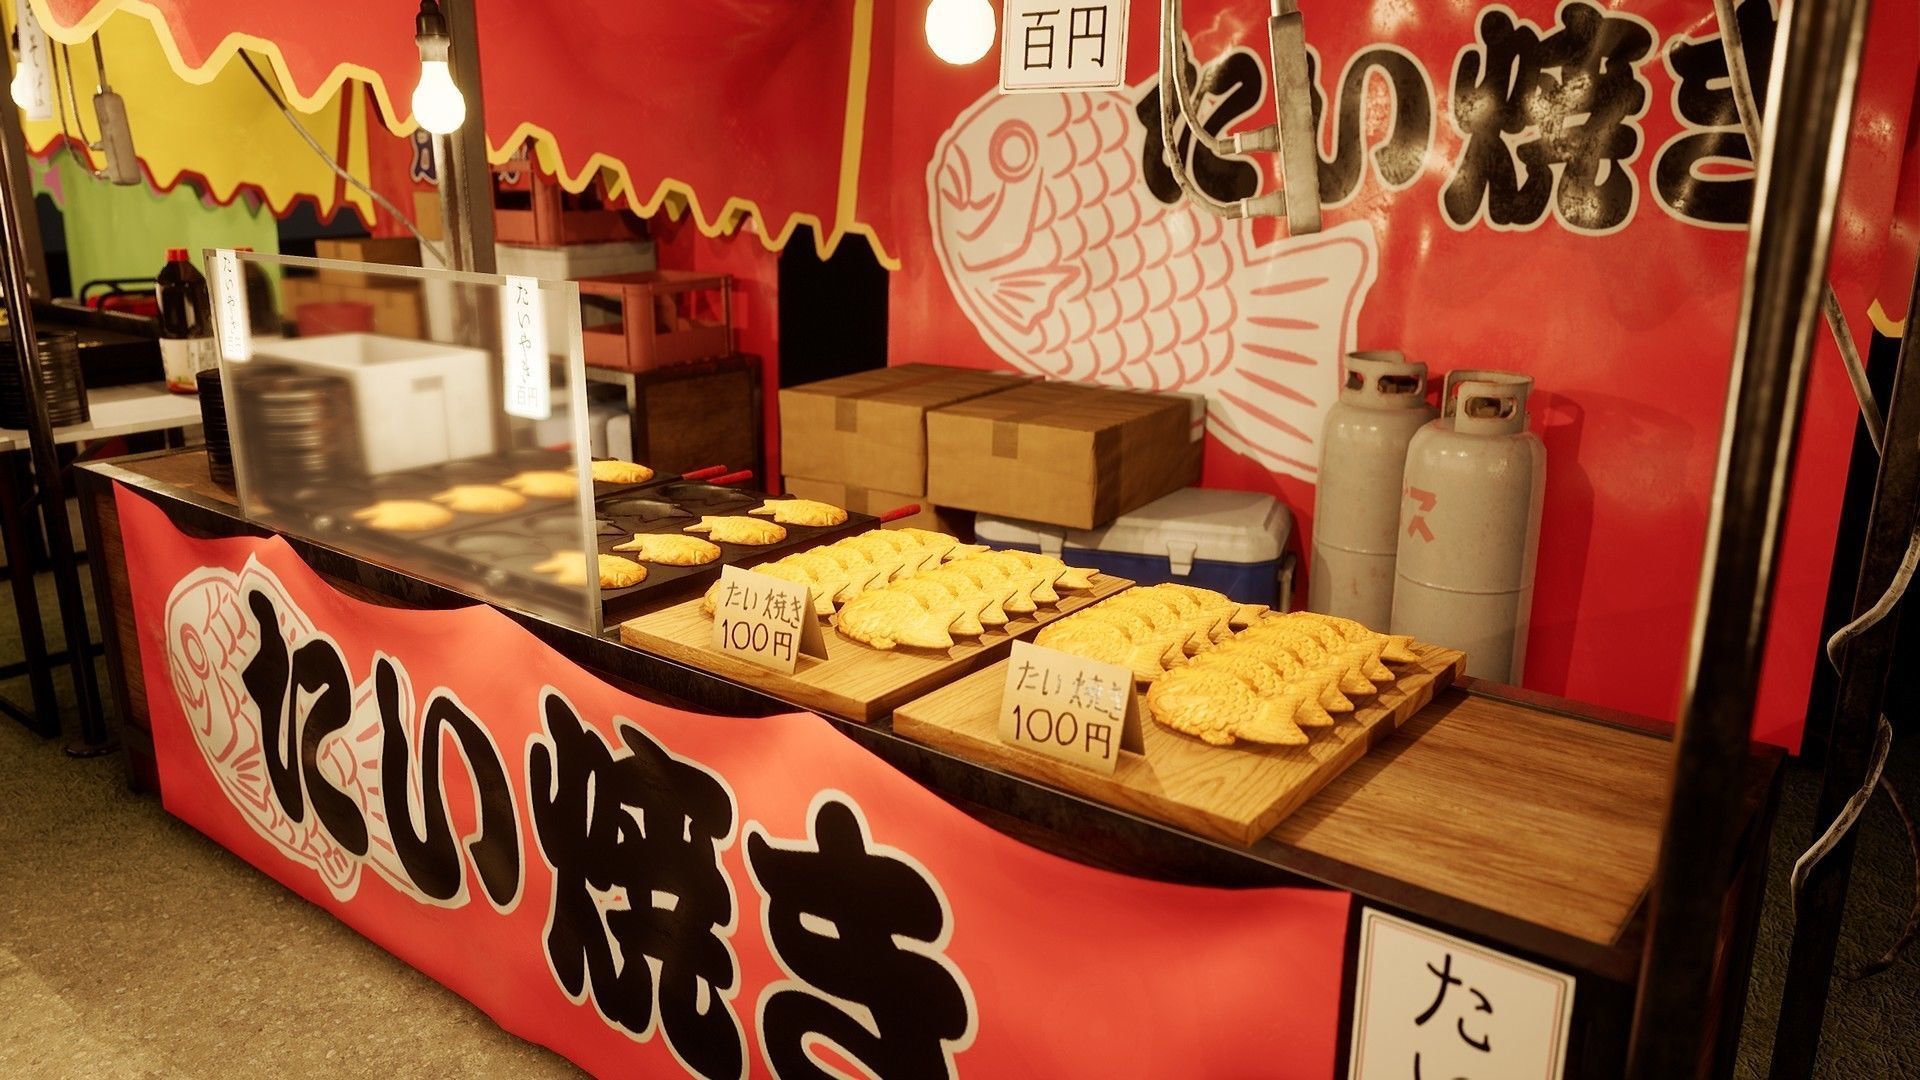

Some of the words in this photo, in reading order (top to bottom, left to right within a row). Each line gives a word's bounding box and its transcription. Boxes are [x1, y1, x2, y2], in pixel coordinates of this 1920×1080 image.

[1021, 4, 1107, 71] 百円
[1403, 479, 1437, 543] ス
[725, 581, 802, 629] たい焼き
[722, 618, 793, 662] 100円
[1017, 660, 1123, 721] たい焼き
[1012, 704, 1112, 759] 100円
[240, 586, 971, 1080] たい焼き
